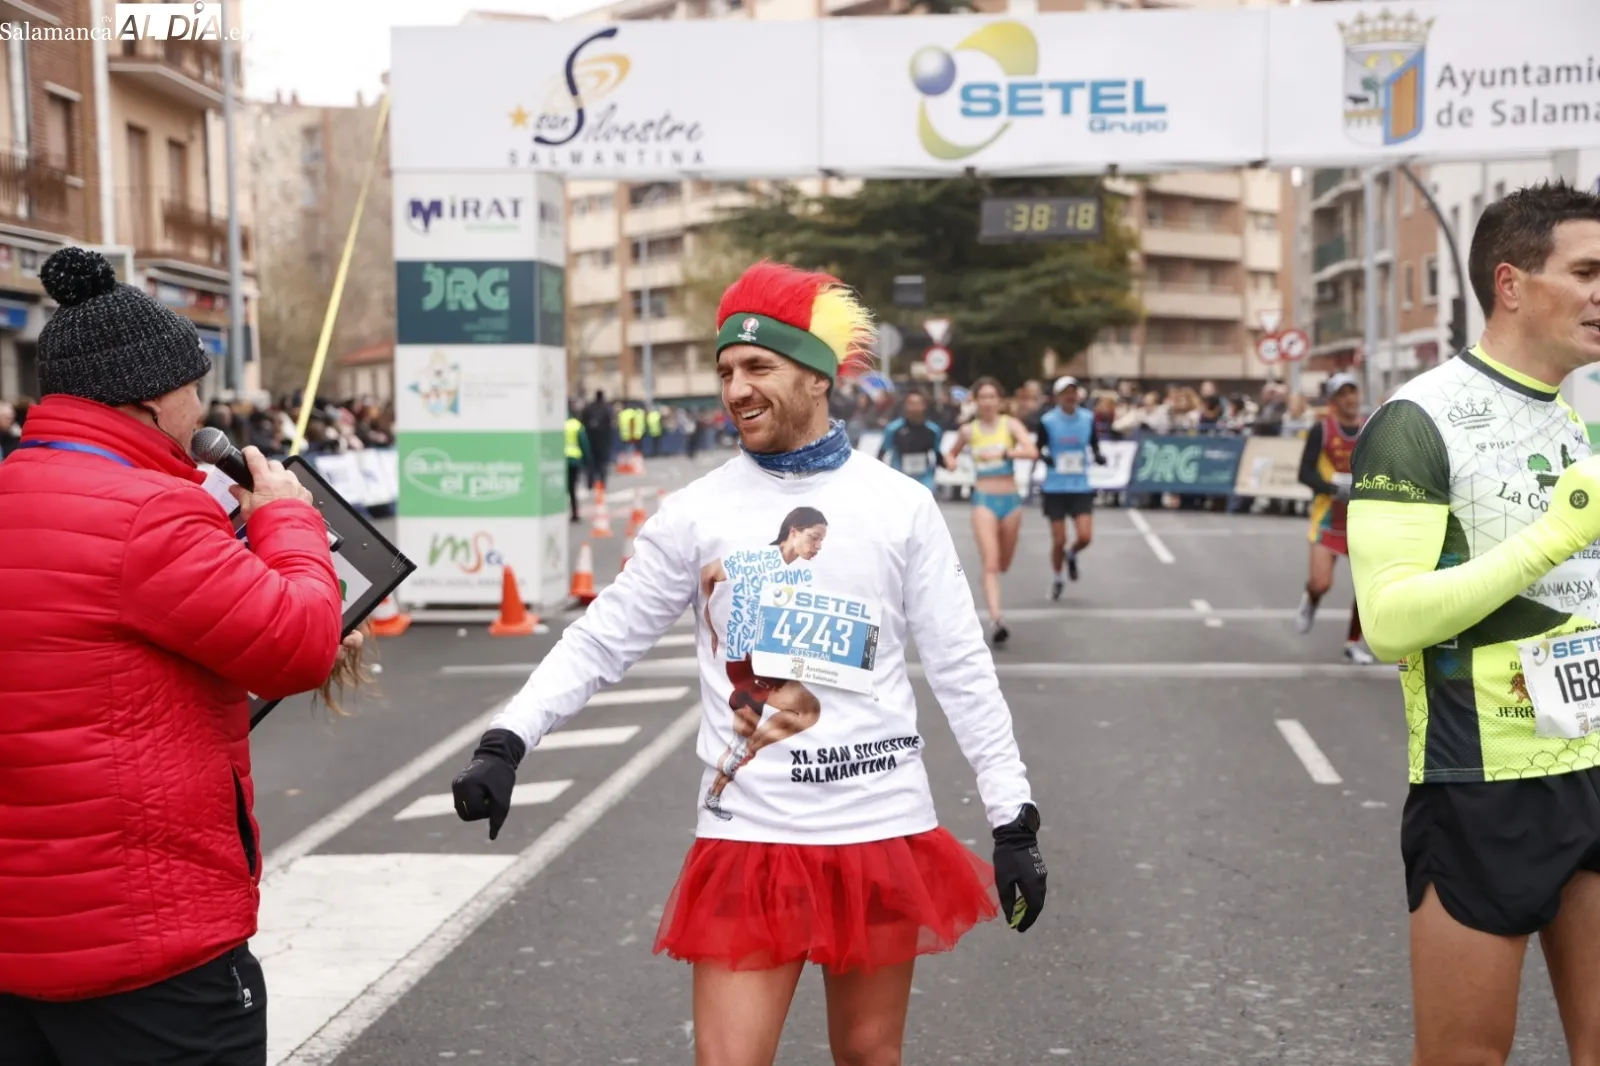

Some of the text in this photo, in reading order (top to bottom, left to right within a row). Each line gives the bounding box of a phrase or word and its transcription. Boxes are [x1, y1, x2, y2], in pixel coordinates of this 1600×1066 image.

[959, 79, 1168, 119] SETEL
[1435, 101, 1475, 127] de
[1088, 117, 1168, 134] Grupo
[508, 149, 706, 166] SALMANTINA
[421, 262, 510, 312] JRG
[1496, 481, 1552, 513] La Co
[793, 590, 872, 621] SETEL
[771, 609, 854, 658] 4243
[1495, 705, 1536, 719] JERR
[817, 745, 851, 765] SAN
[854, 735, 920, 761] SILVESTRE
[790, 754, 898, 784] SALMANTINA
